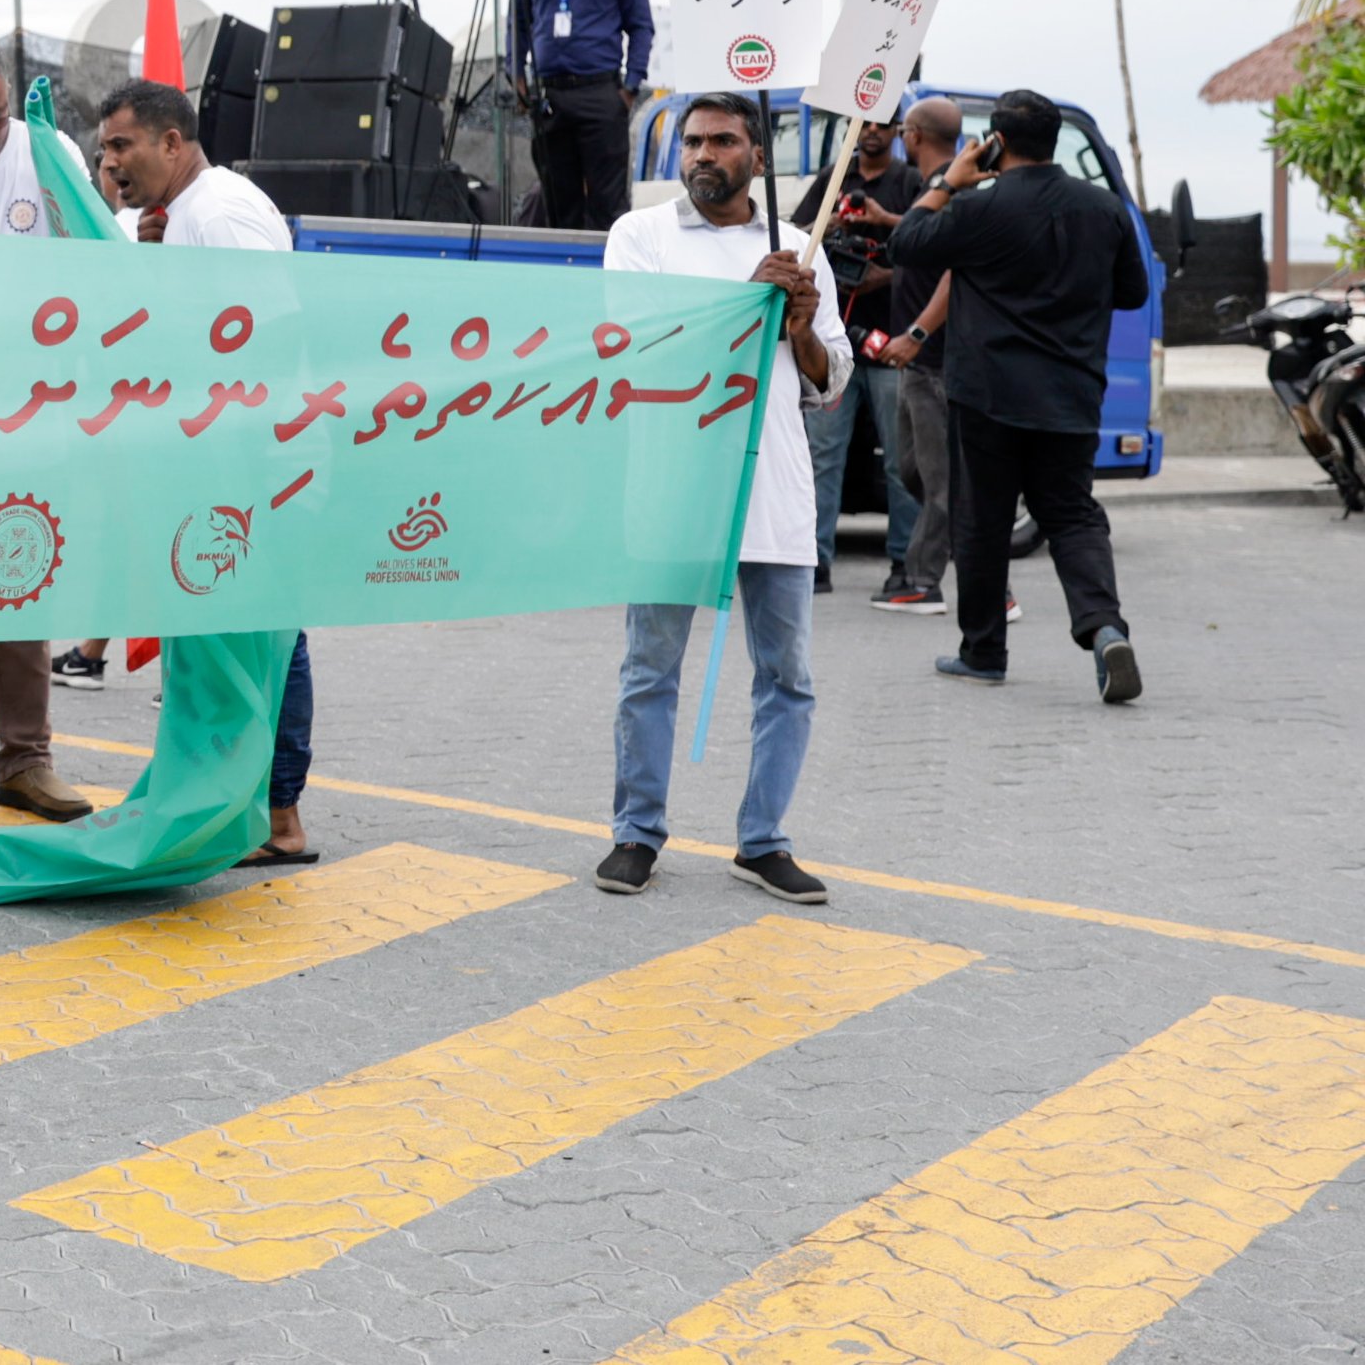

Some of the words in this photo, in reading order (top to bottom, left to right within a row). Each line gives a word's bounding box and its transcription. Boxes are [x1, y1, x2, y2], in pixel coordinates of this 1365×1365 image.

[733, 53, 769, 65] TEAM
[376, 559, 416, 570] MALDIVES
[417, 556, 449, 570] HEALTH
[365, 570, 432, 584] PROFESSIONALS
[434, 569, 460, 582] UNION
